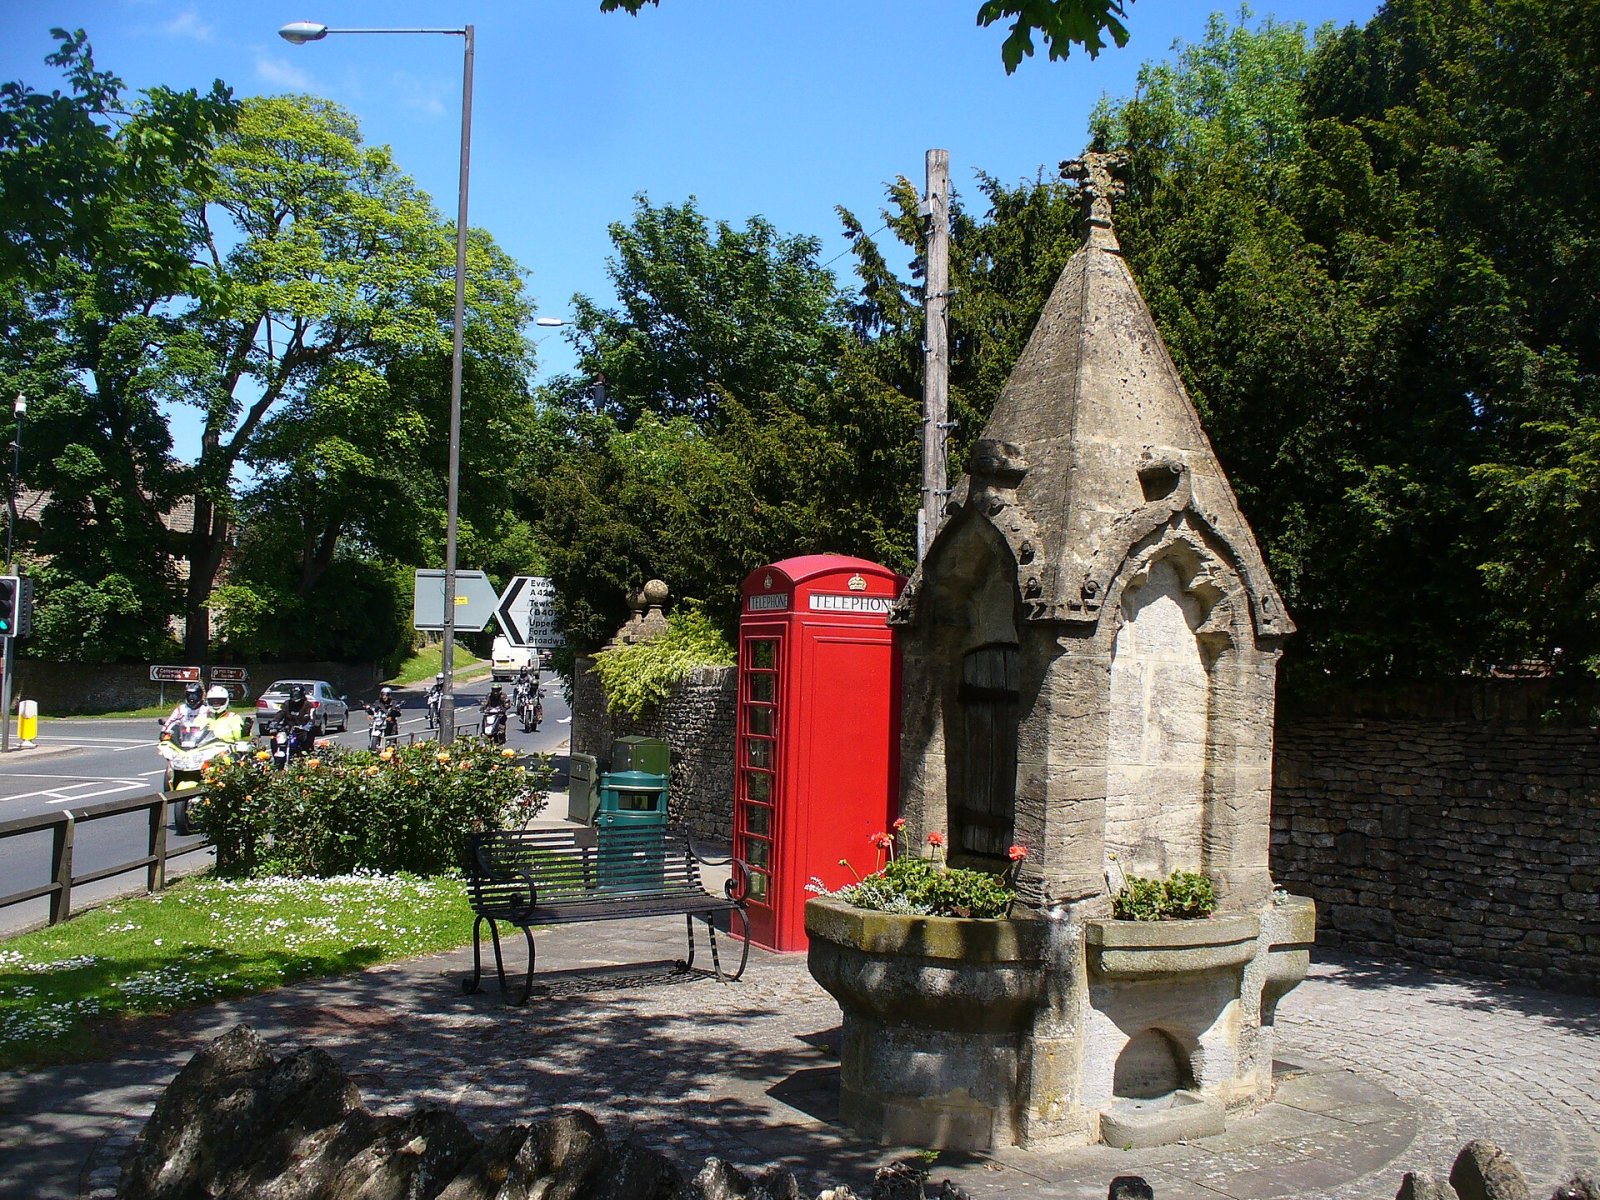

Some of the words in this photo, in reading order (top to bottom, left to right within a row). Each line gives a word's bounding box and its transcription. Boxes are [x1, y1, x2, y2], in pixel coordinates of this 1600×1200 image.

[529, 600, 551, 608] Tewk
[752, 594, 788, 609] TELEPHONE
[529, 628, 548, 636] Ford
